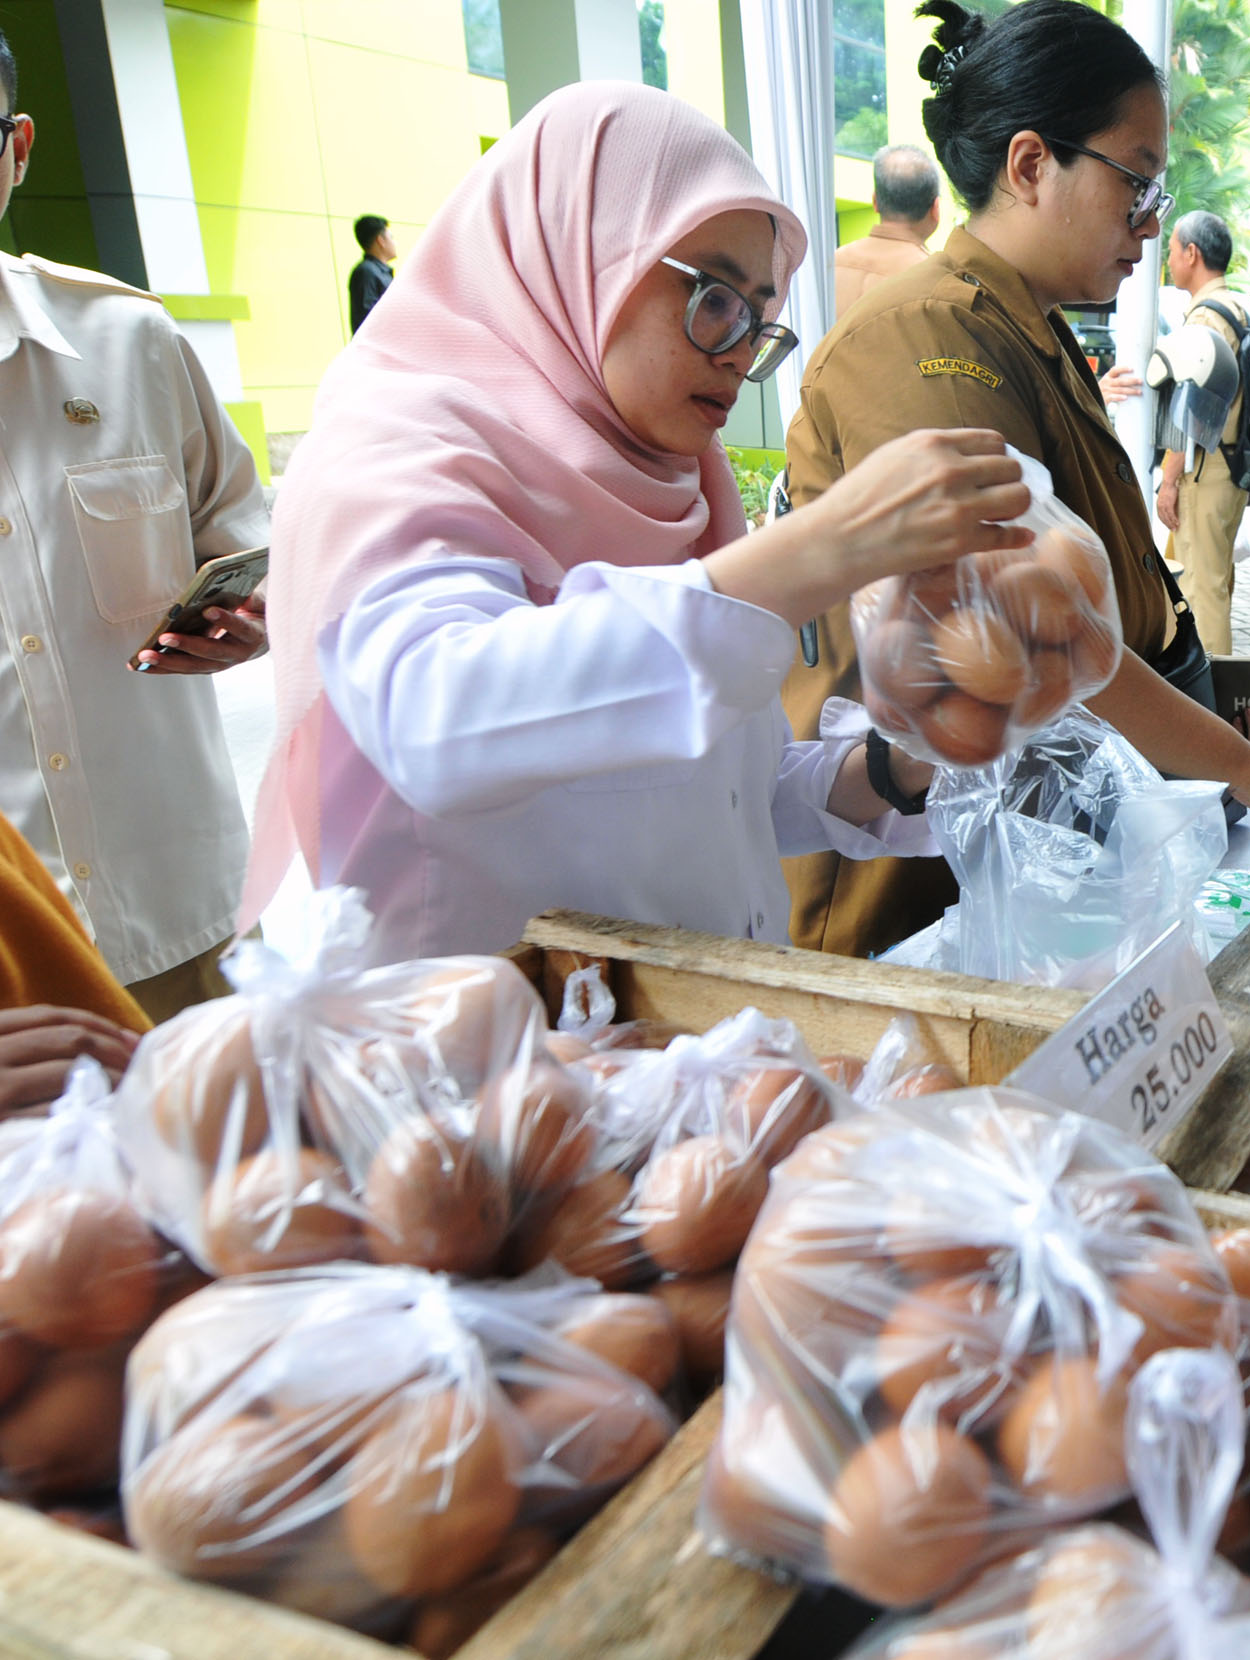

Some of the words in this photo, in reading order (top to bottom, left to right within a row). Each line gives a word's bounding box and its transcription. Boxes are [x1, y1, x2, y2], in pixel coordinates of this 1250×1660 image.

[921, 359, 998, 386] KEMENDAGRI
[1075, 987, 1165, 1086] Harga
[1131, 1011, 1217, 1134] 25.000
